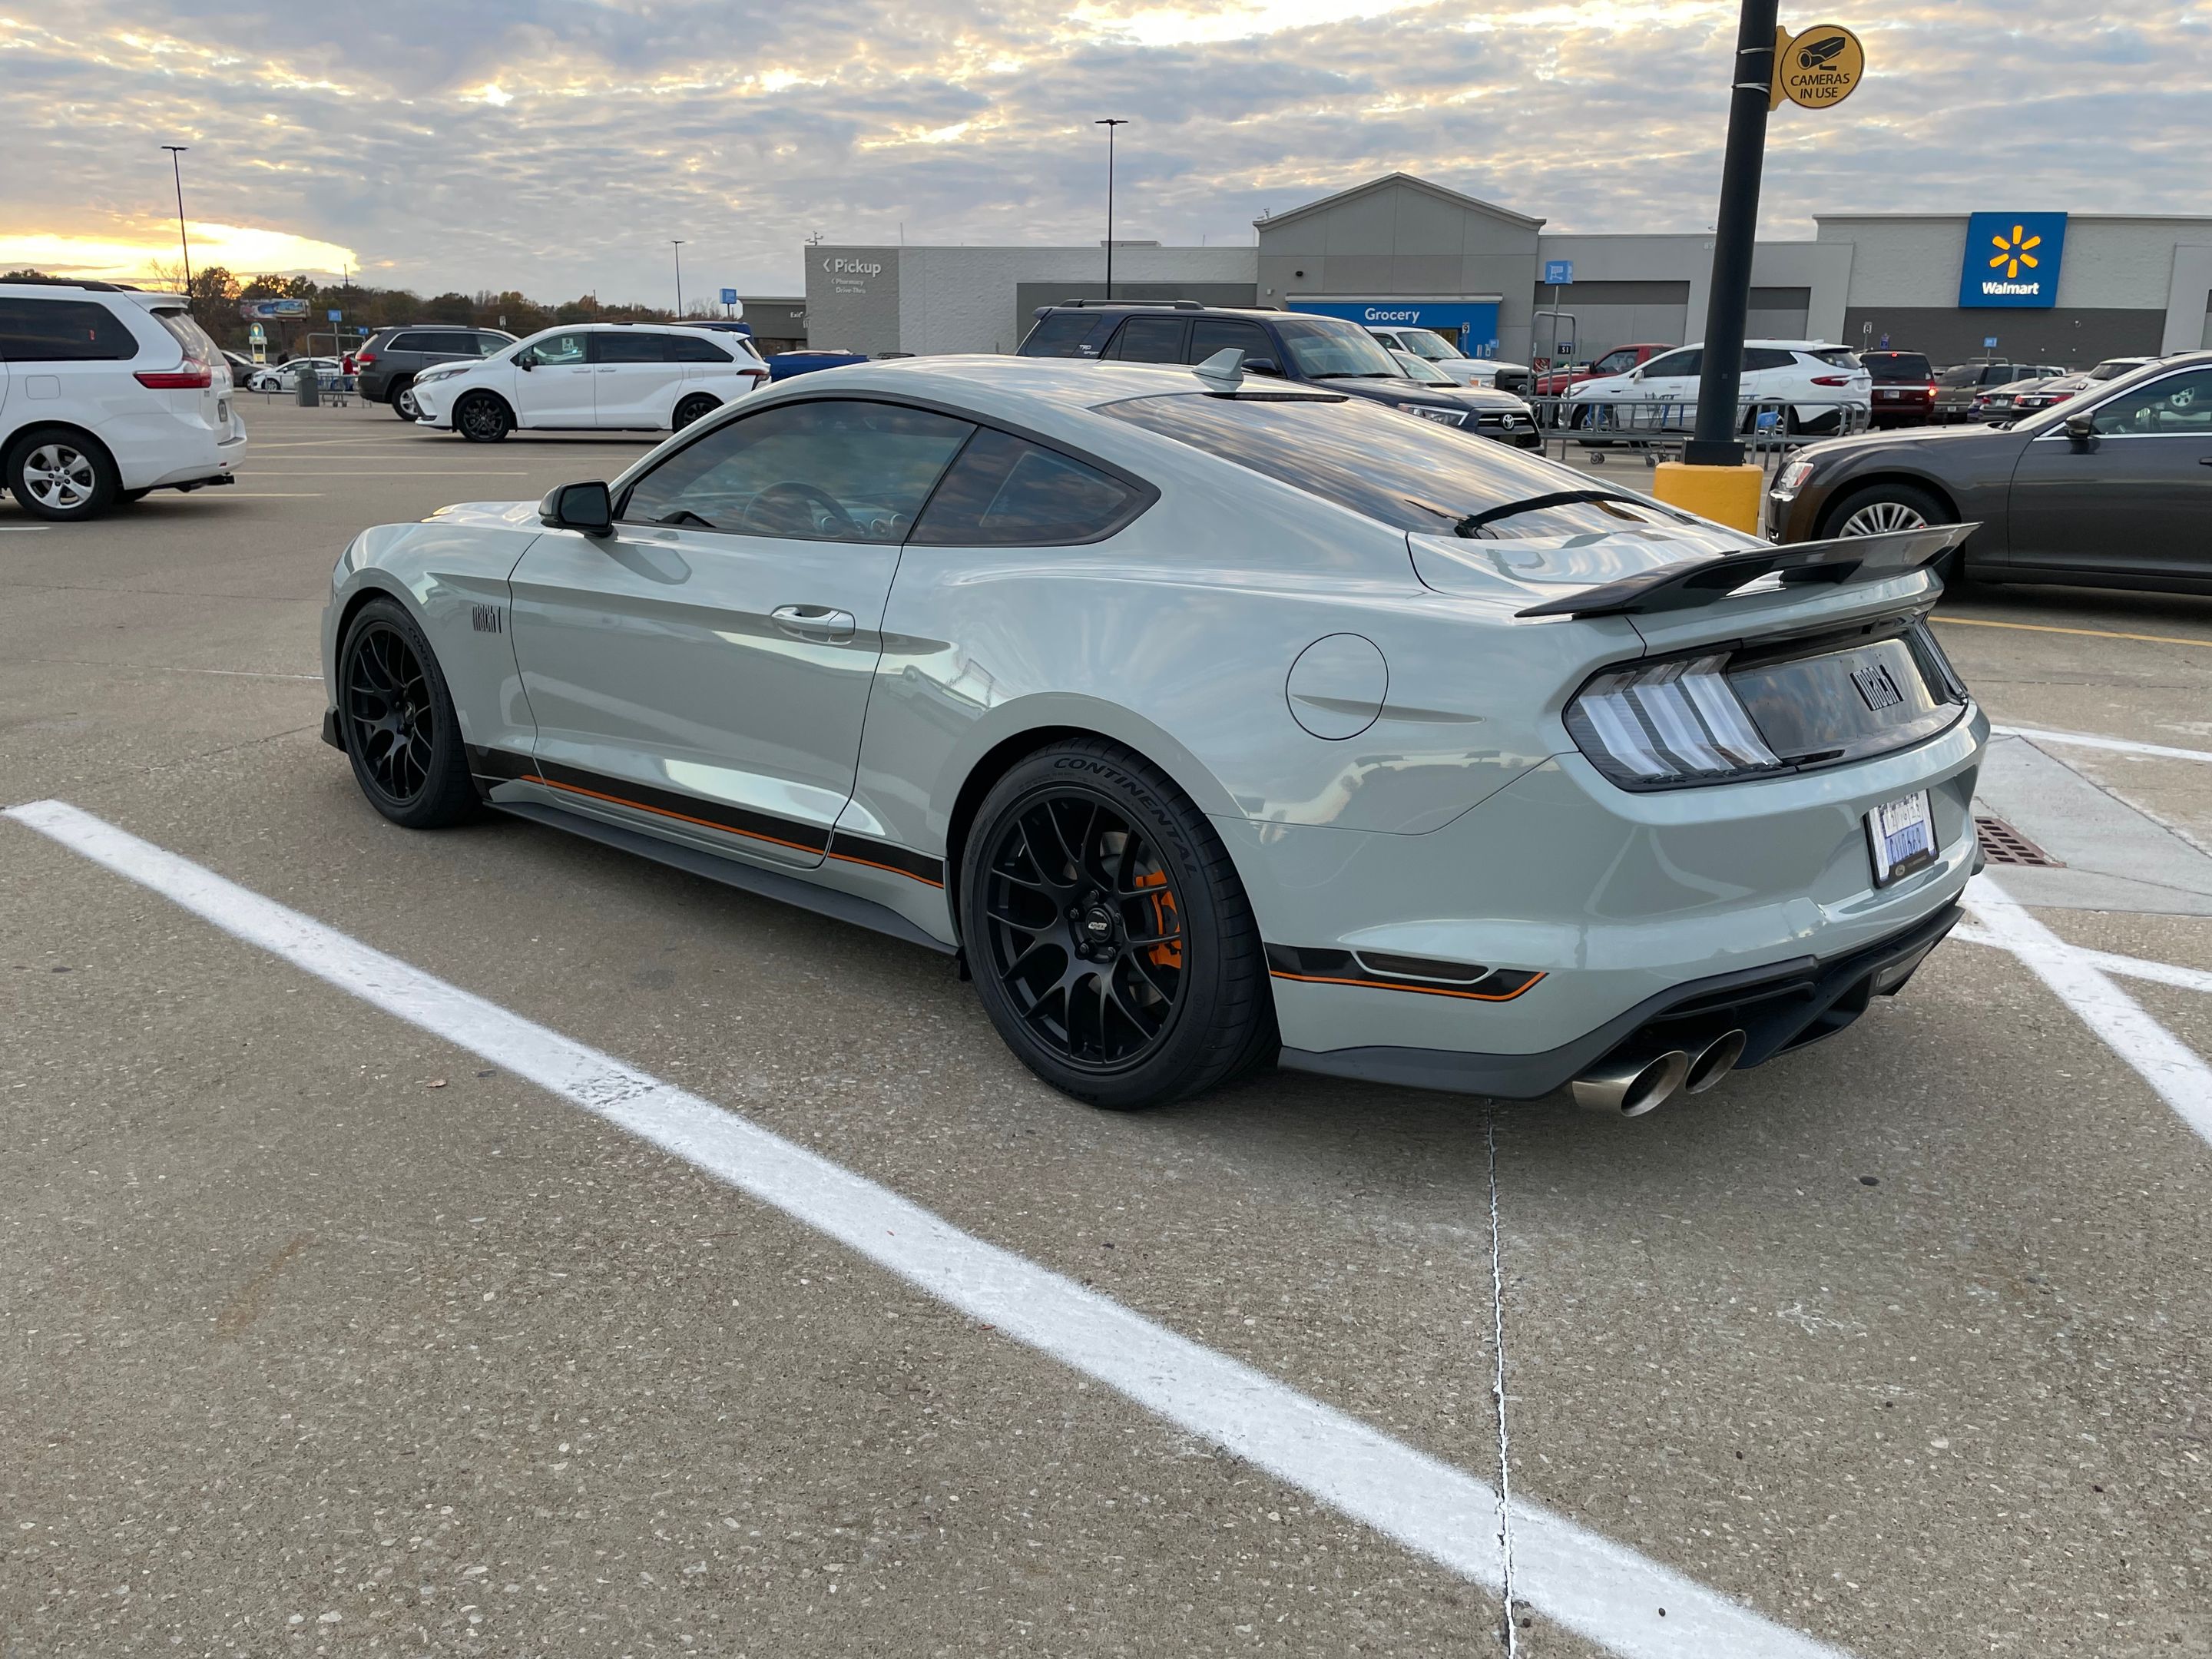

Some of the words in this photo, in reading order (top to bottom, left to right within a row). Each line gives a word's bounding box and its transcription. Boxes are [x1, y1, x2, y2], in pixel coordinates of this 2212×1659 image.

[1790, 73, 1850, 87] CAMERAS
[1800, 88, 1813, 99] IN
[1816, 87, 1839, 98] USE
[835, 258, 882, 277] Pickup
[836, 278, 864, 286] Pharmacy
[1982, 282, 2040, 295] Walmart
[1364, 307, 1420, 324] Grocery
[1054, 757, 1198, 879] CONTINENTAL
